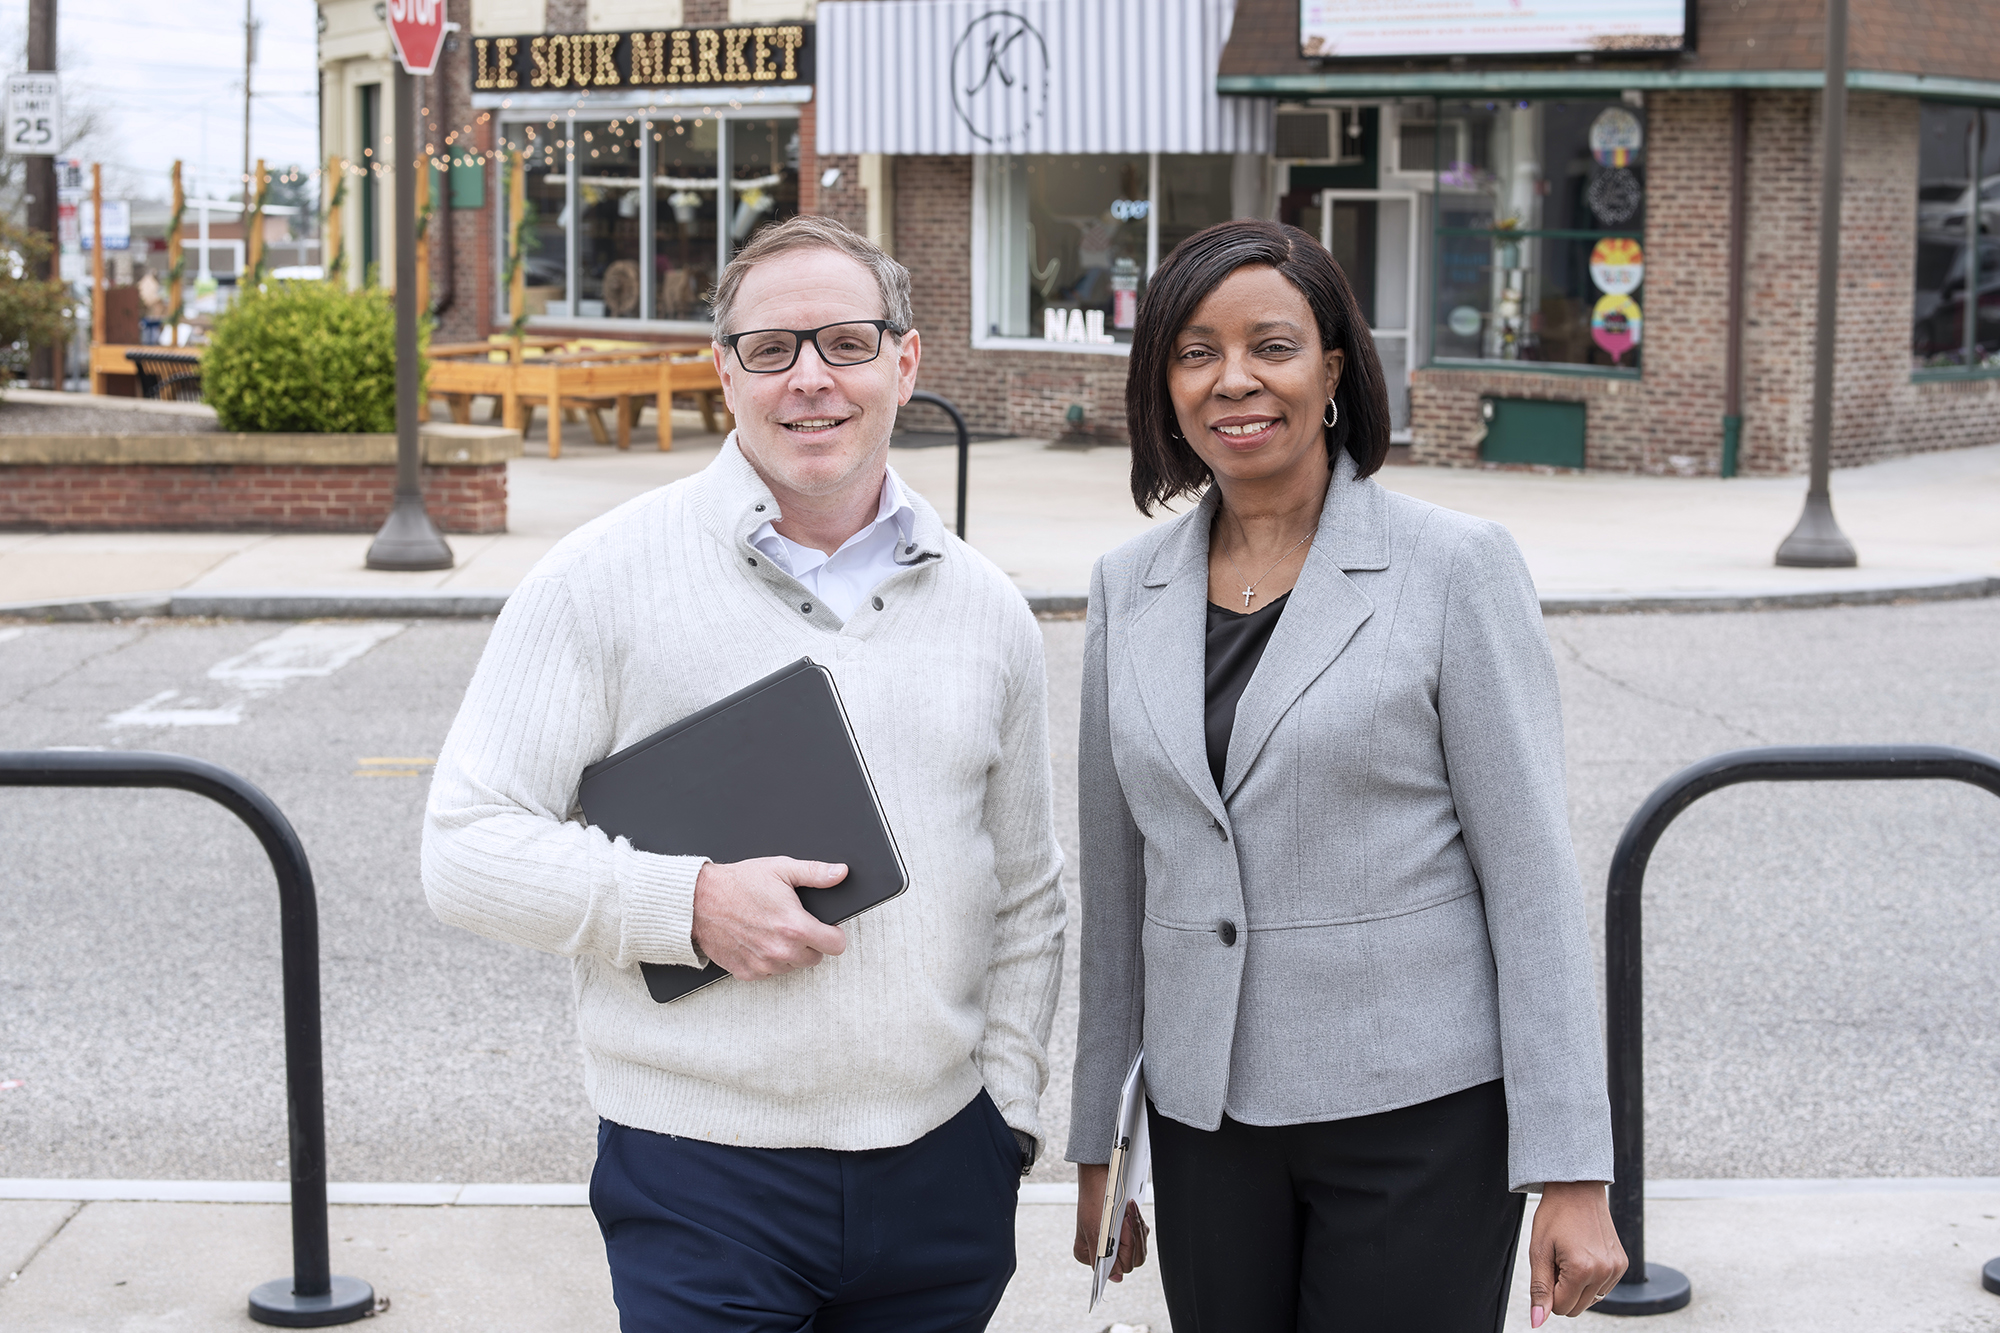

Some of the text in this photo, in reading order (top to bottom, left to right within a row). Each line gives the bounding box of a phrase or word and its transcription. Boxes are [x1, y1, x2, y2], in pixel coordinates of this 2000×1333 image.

[475, 25, 802, 89] LE SOUK MARKET
[11, 83, 53, 94] SPEED
[15, 118, 52, 145] 25
[1044, 307, 1115, 345] NAIL
